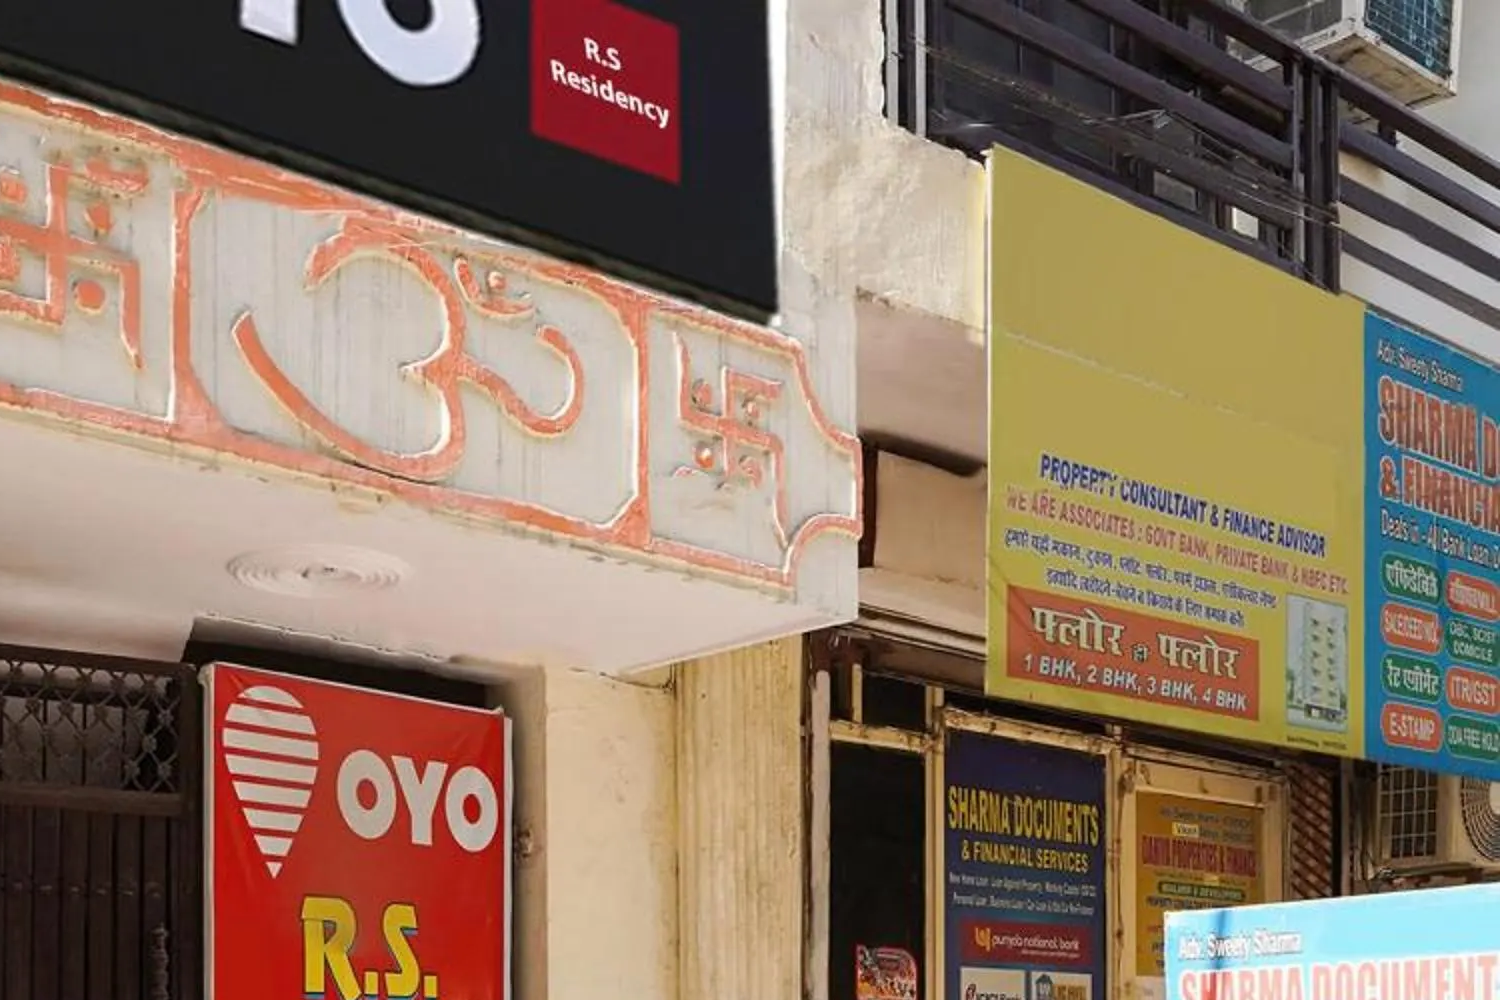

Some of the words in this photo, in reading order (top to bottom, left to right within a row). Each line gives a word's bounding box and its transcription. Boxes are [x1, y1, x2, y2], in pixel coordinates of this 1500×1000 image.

[583, 36, 623, 71] R.S
[550, 59, 671, 129] Residency
[1378, 374, 1480, 477] SHARMA
[1041, 453, 1118, 497] PROPERTY
[1120, 479, 1206, 524] CONSULTANT
[1210, 506, 1219, 528] &
[1223, 508, 1275, 543] FINANCE
[1278, 523, 1325, 558] ADVISOR
[1379, 455, 1400, 502] &
[1007, 486, 1027, 511] WE
[1032, 492, 1055, 518] ARE
[1060, 501, 1135, 540] ASSOCIATES
[1144, 525, 1176, 552] GOVT
[1216, 541, 1258, 574] PRIVATE
[1261, 553, 1289, 580] BANK
[1032, 603, 1125, 657] फ्लोर
[1157, 632, 1240, 680] फ्लोर
[1025, 653, 1033, 673] 1
[1038, 654, 1081, 685] BHK,
[1087, 666, 1098, 684] 2
[1102, 667, 1142, 695] BHK,
[1147, 676, 1157, 694] 3
[1161, 678, 1198, 703] BHK,
[1202, 685, 1211, 703] 4
[1215, 690, 1248, 712] BHK
[1389, 712, 1436, 742] E-STAMP
[337, 749, 498, 853] OYO
[948, 785, 1011, 834] SHARMA
[1013, 793, 1099, 847] DOCUMENTS
[961, 839, 970, 861] &
[973, 841, 1034, 867] FINANCIAL
[1036, 848, 1090, 874] SERVICES
[1023, 935, 1057, 950] national
[1059, 937, 1080, 951] bank
[1207, 930, 1250, 963] Sweety
